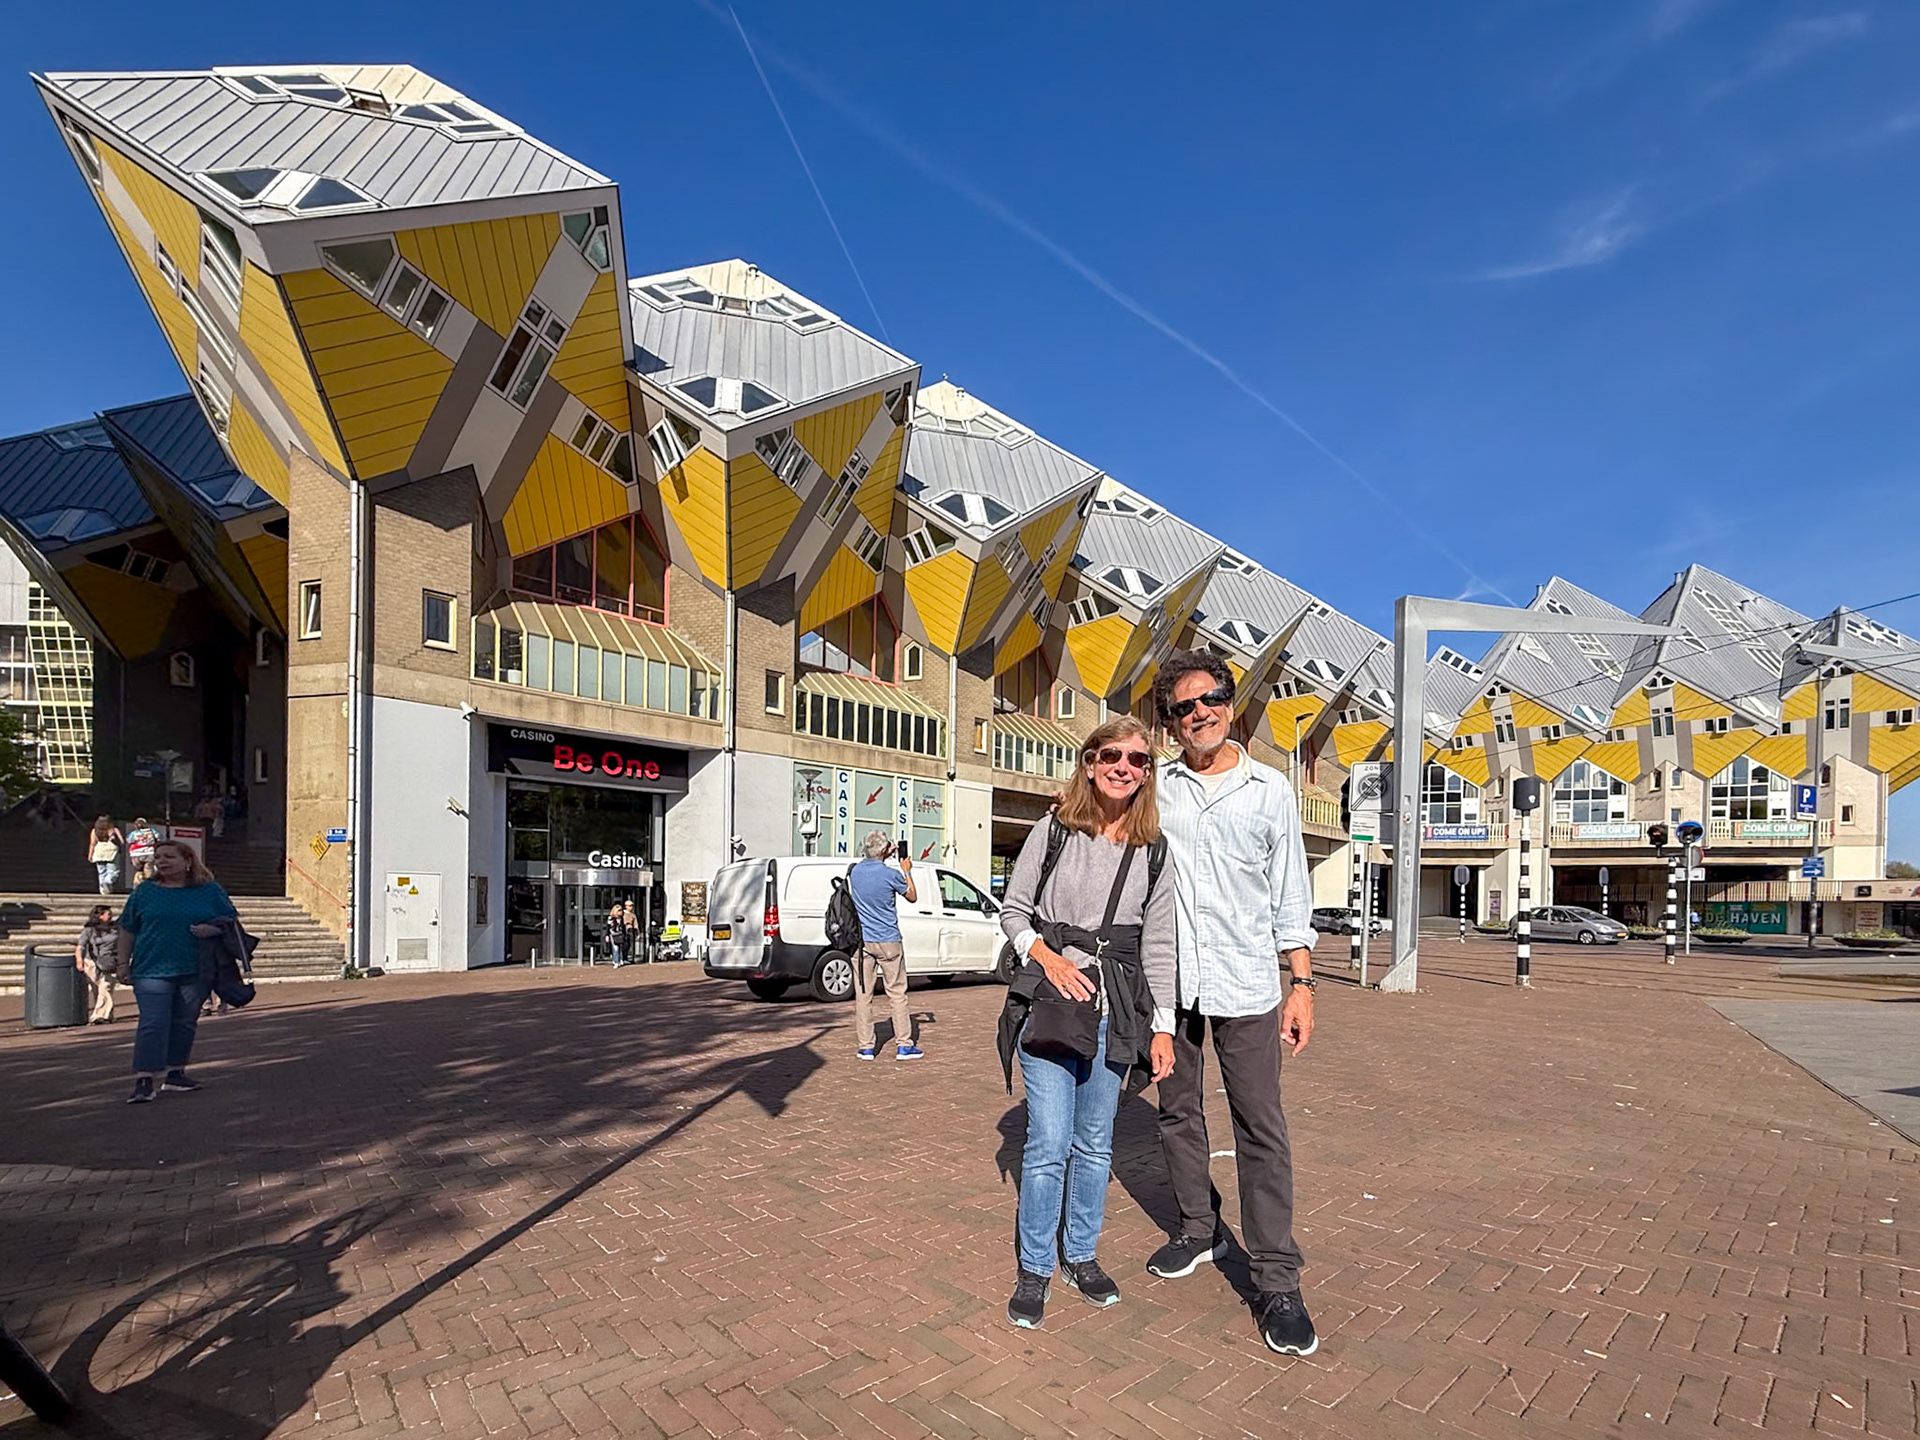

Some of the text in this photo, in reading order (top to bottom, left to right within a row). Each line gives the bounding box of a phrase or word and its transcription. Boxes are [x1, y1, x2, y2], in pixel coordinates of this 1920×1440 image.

[510, 728, 555, 743] CASINO
[553, 745, 661, 779] Be One
[1802, 788, 1811, 803] P
[1433, 827, 1457, 836] COME
[1458, 827, 1470, 836] ON
[1471, 826, 1485, 836] UP!
[1743, 823, 1772, 832] COME
[1773, 823, 1788, 832] ON
[588, 850, 644, 868] Casino
[1731, 912, 1781, 924] HAVEN
